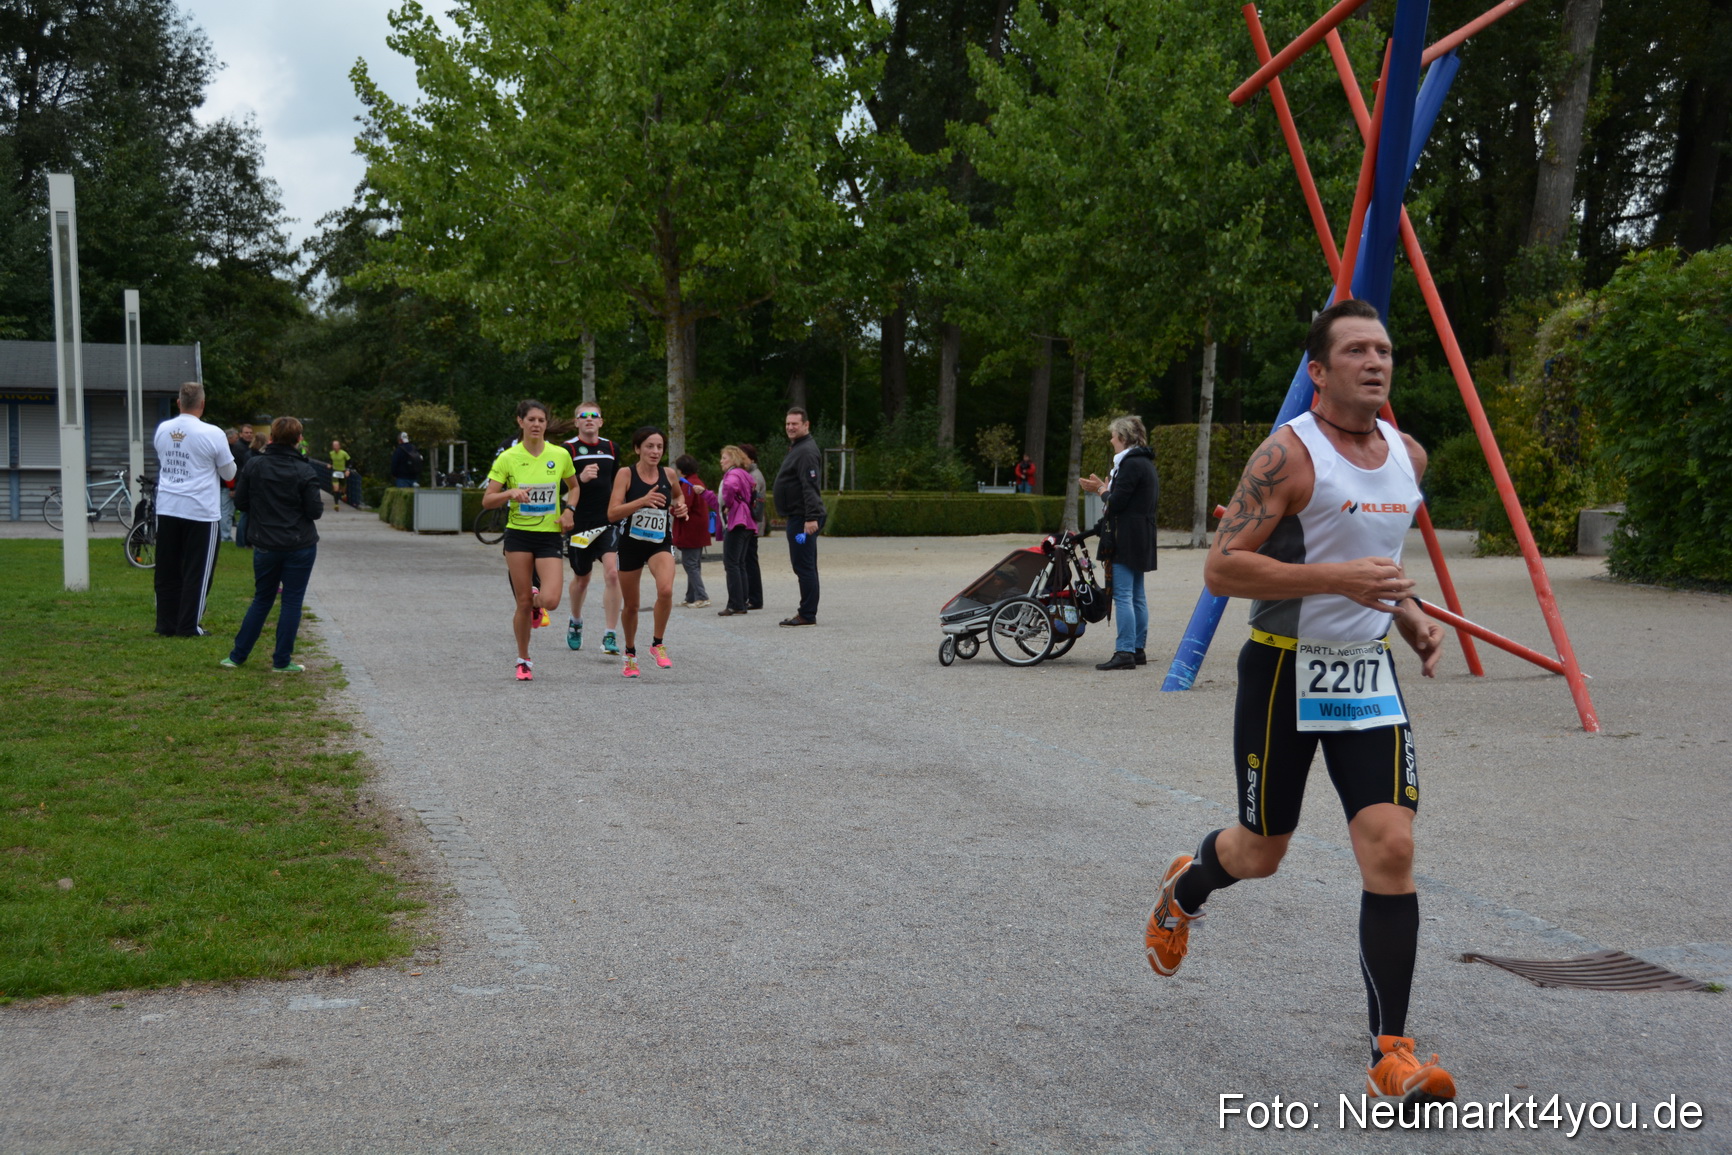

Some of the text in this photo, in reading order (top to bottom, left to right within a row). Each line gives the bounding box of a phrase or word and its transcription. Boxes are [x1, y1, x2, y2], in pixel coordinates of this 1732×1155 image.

[165, 450, 190, 460] AUFTRAG
[167, 459, 187, 467] SEINER
[1361, 503, 1409, 514] KLEBL
[635, 515, 665, 531] 2703
[1300, 645, 1335, 656] PARTL
[1308, 659, 1380, 694] 2207
[1319, 702, 1382, 720] Wolfgang
[1404, 729, 1417, 787] SKINS
[1246, 768, 1258, 825] SKINS
